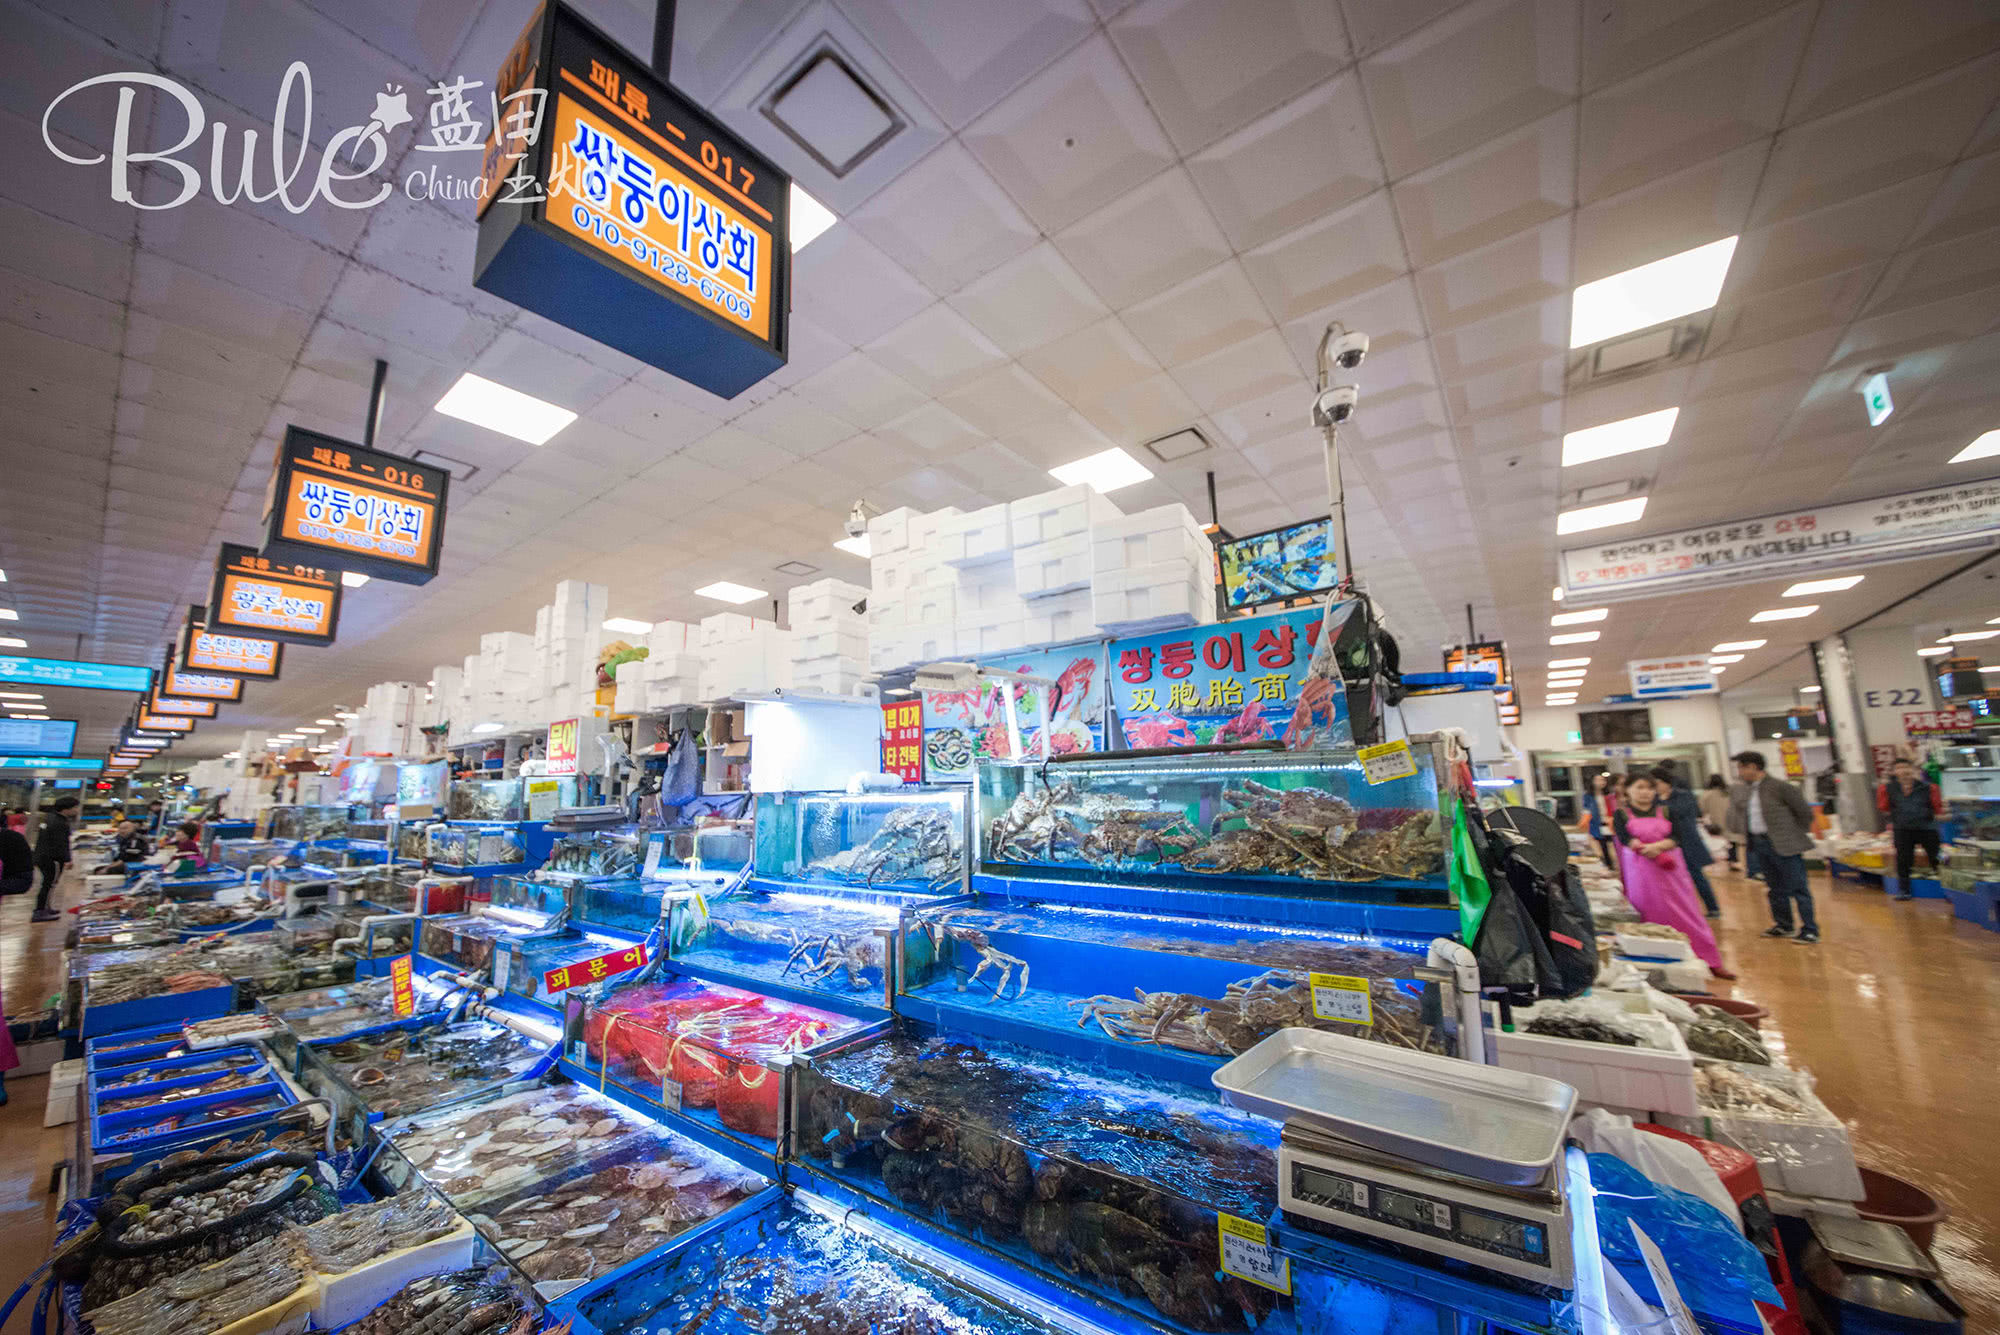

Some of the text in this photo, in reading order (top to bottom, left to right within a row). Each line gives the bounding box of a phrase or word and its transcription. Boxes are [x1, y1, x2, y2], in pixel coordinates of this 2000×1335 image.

[589, 57, 651, 122] 패류
[700, 140, 756, 195] 017
[568, 117, 758, 298] 쌍둥이상회
[571, 202, 752, 322] 010-9128-6709
[384, 466, 424, 490] 016
[299, 480, 425, 545] 쌍둥이상회
[293, 564, 326, 580] 015
[1127, 672, 1308, 712] 双胞胎商
[1887, 688, 1924, 707] 22
